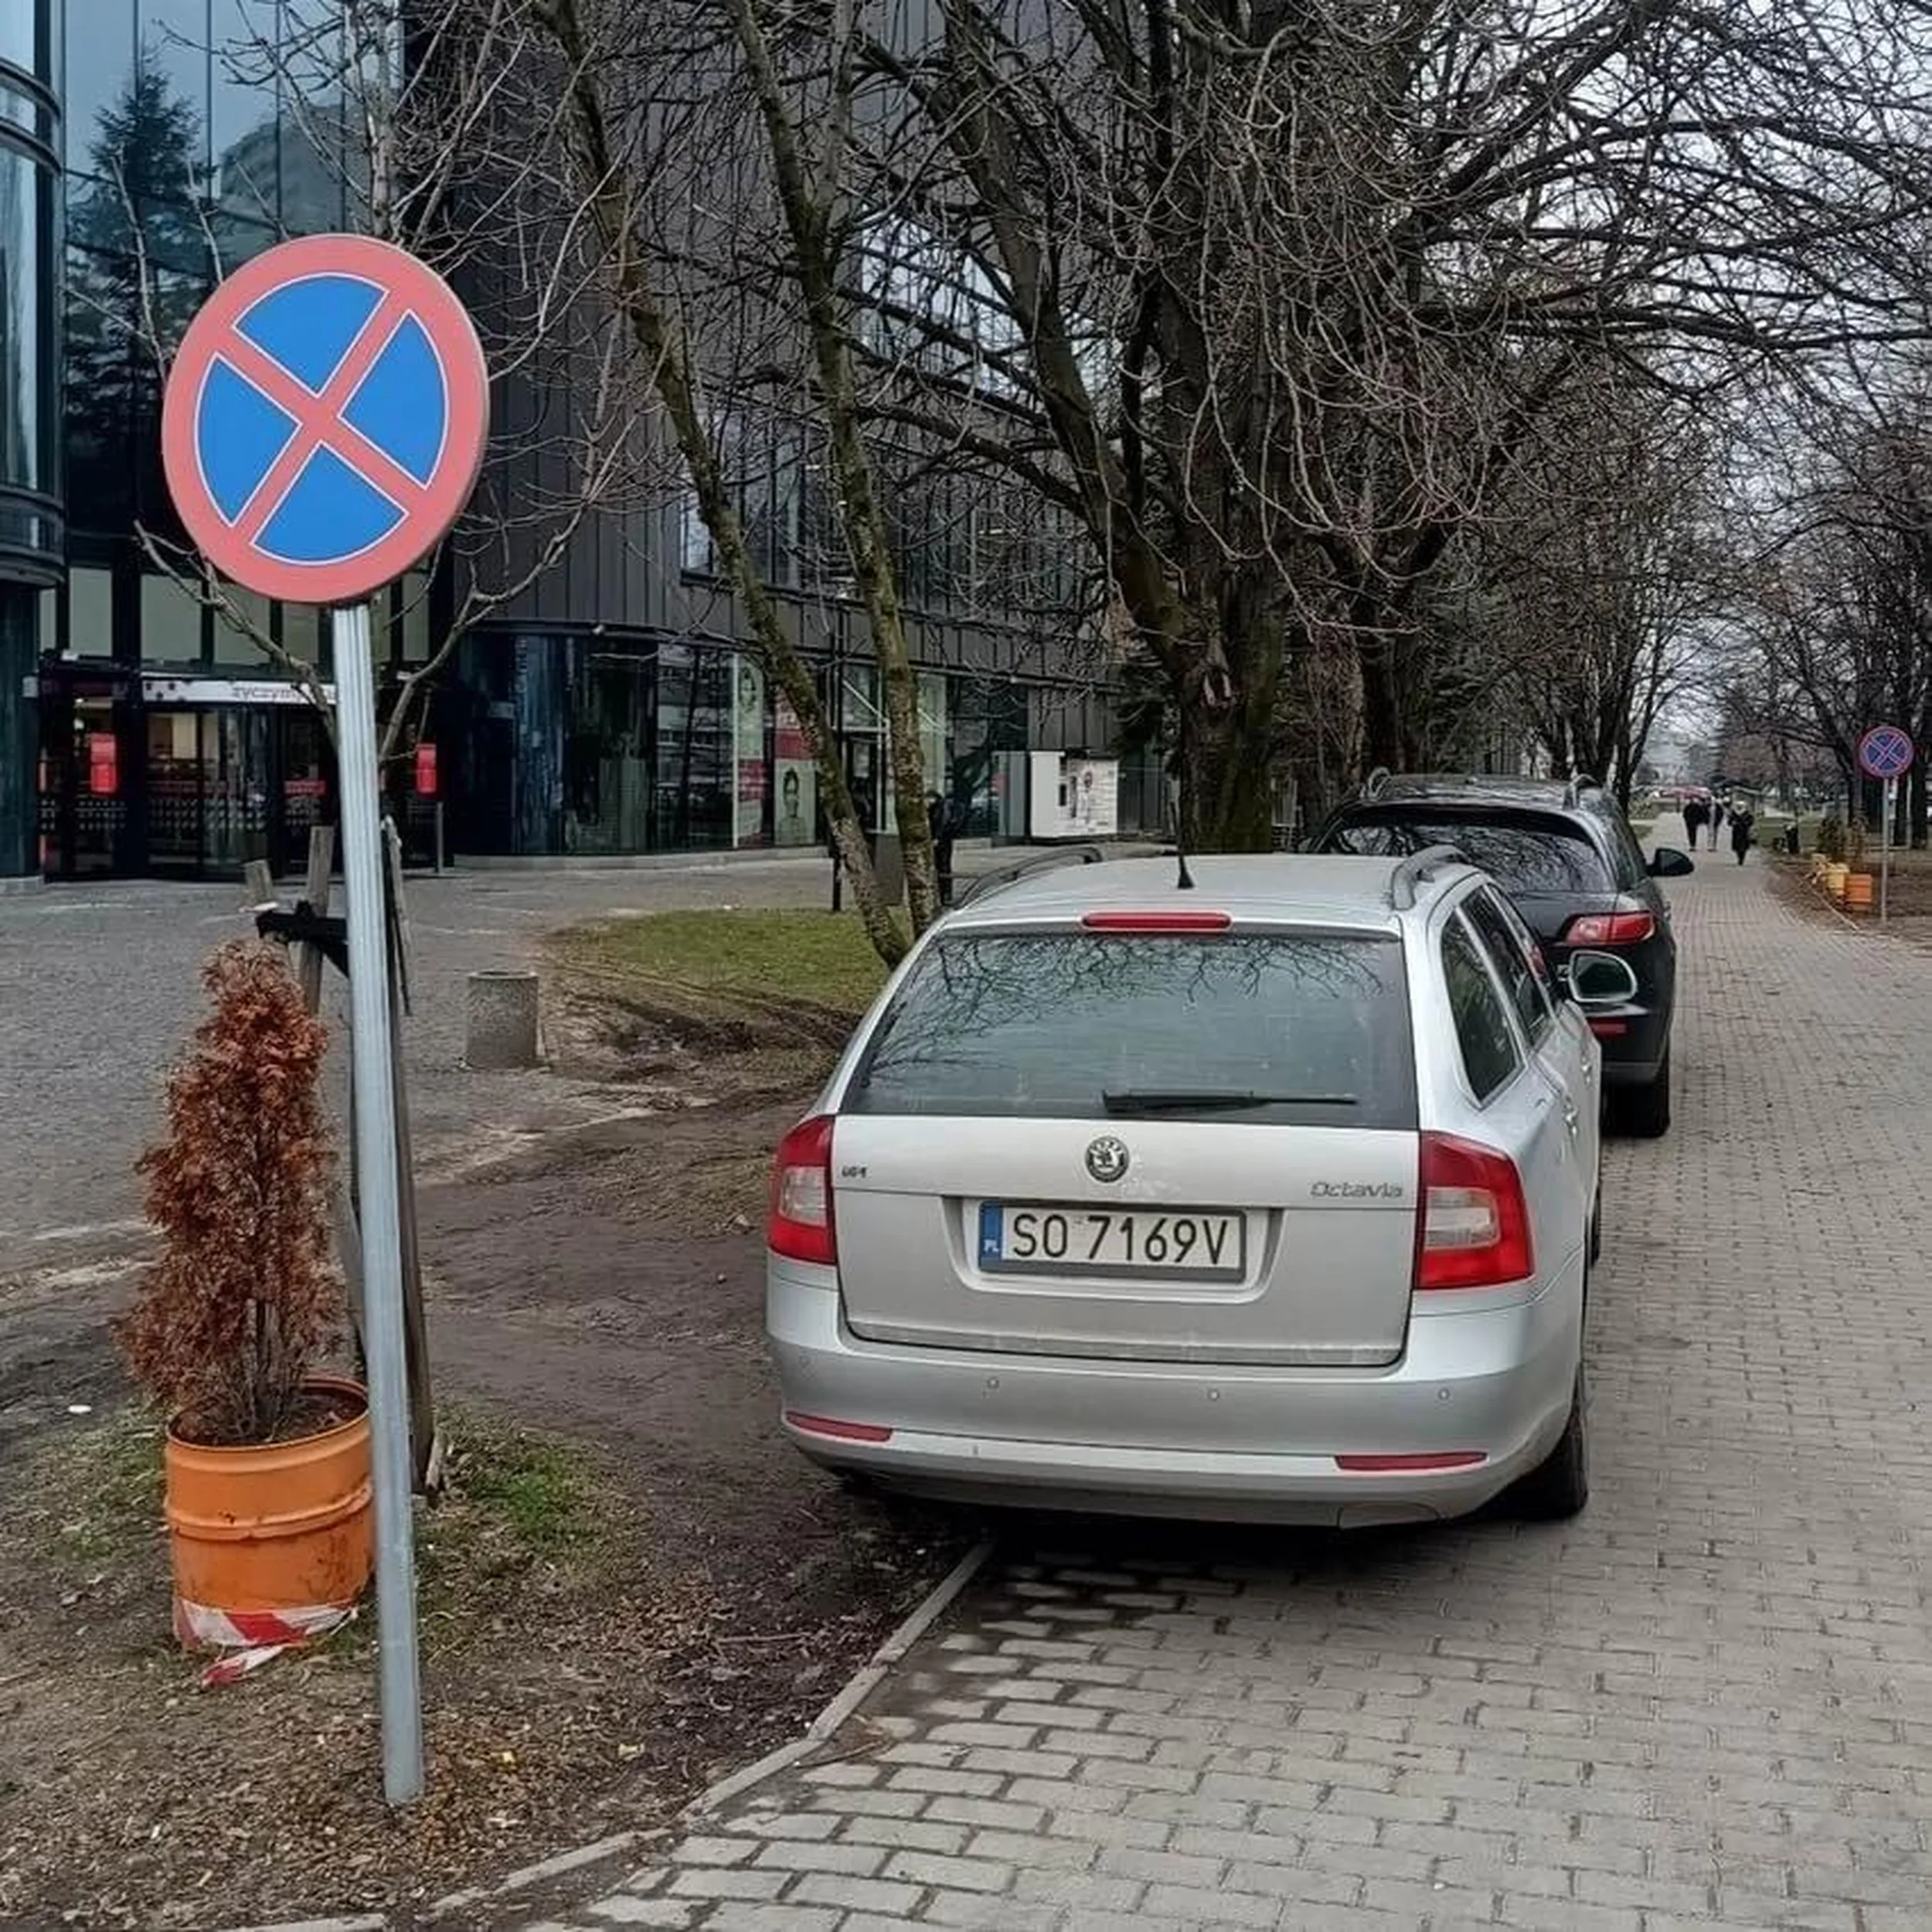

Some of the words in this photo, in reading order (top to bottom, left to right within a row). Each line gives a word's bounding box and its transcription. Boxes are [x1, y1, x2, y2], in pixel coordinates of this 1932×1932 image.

[1309, 1181, 1404, 1198] Octavia
[1012, 1213, 1068, 1258] SO
[1087, 1215, 1228, 1265] 7169V
